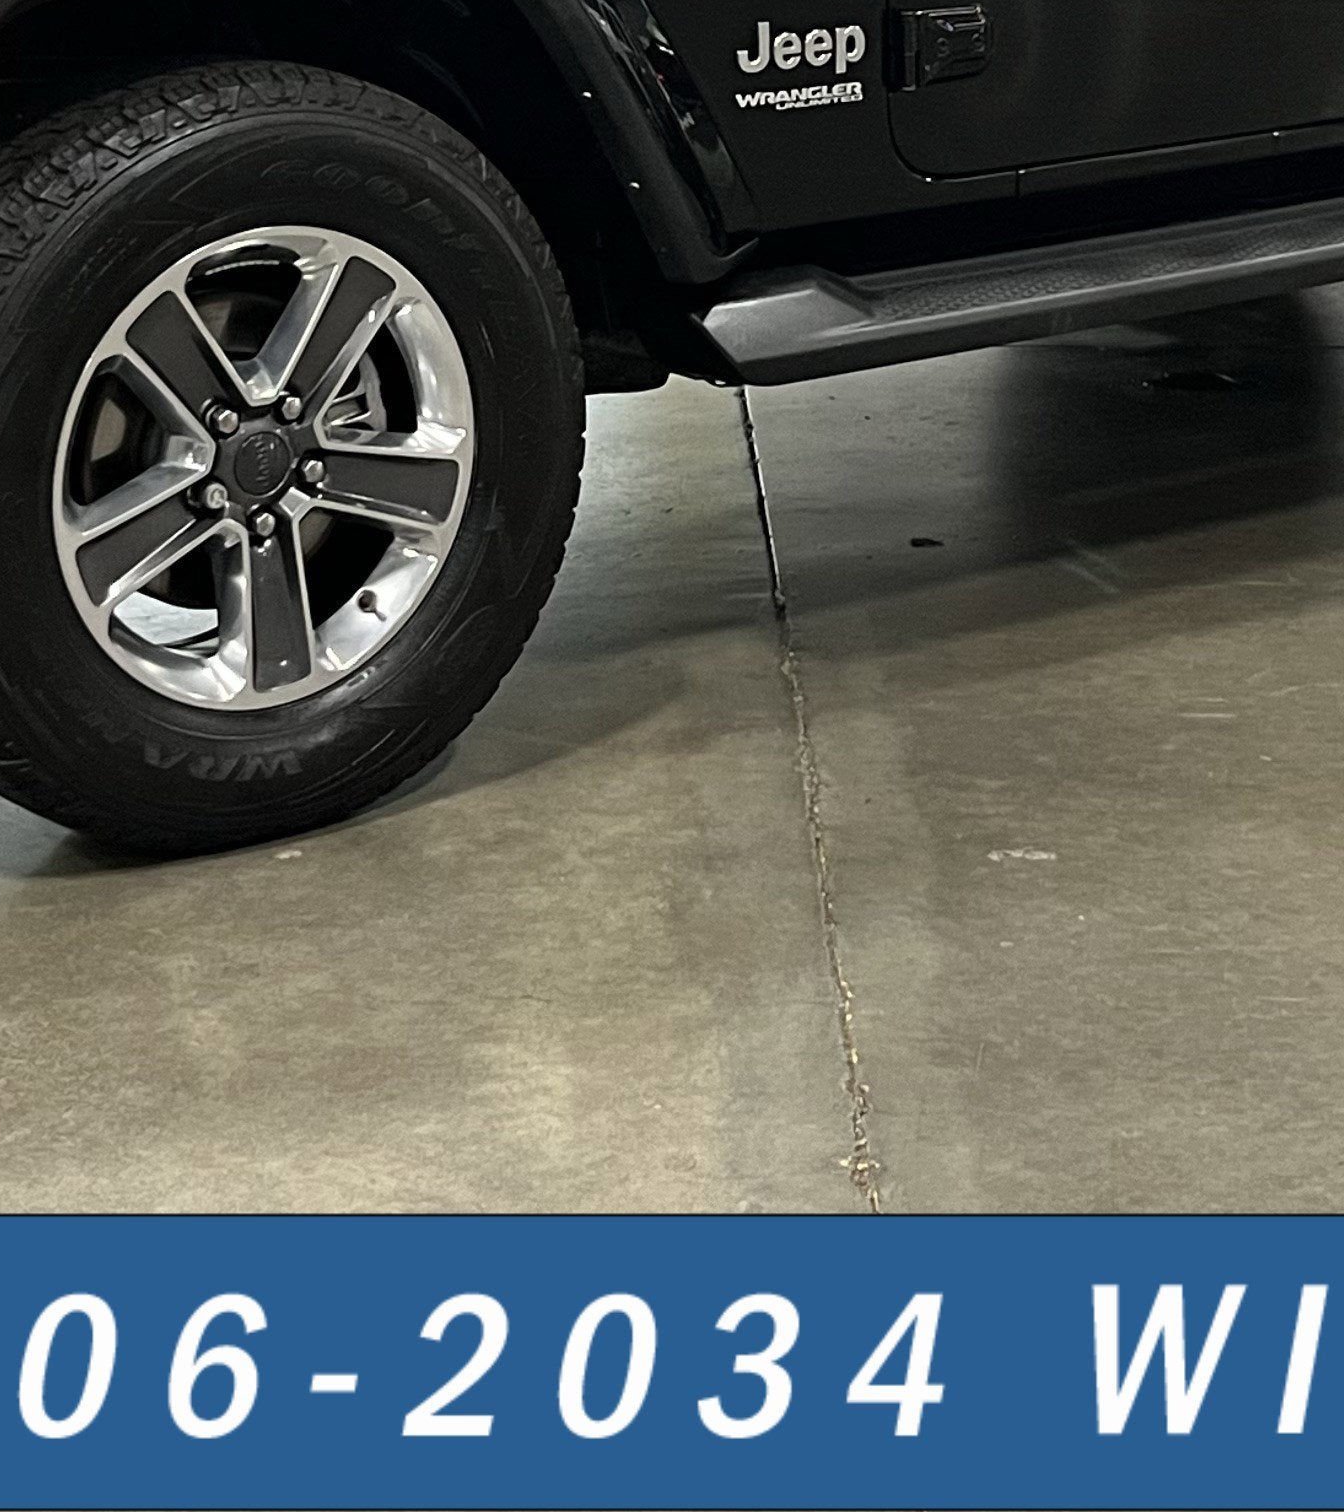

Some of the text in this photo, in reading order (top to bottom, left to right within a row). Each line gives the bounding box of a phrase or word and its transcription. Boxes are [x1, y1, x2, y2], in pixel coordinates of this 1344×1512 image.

[736, 20, 867, 75] Jeep
[734, 81, 863, 109] WRANGLER
[775, 92, 865, 111] UNLIMITED
